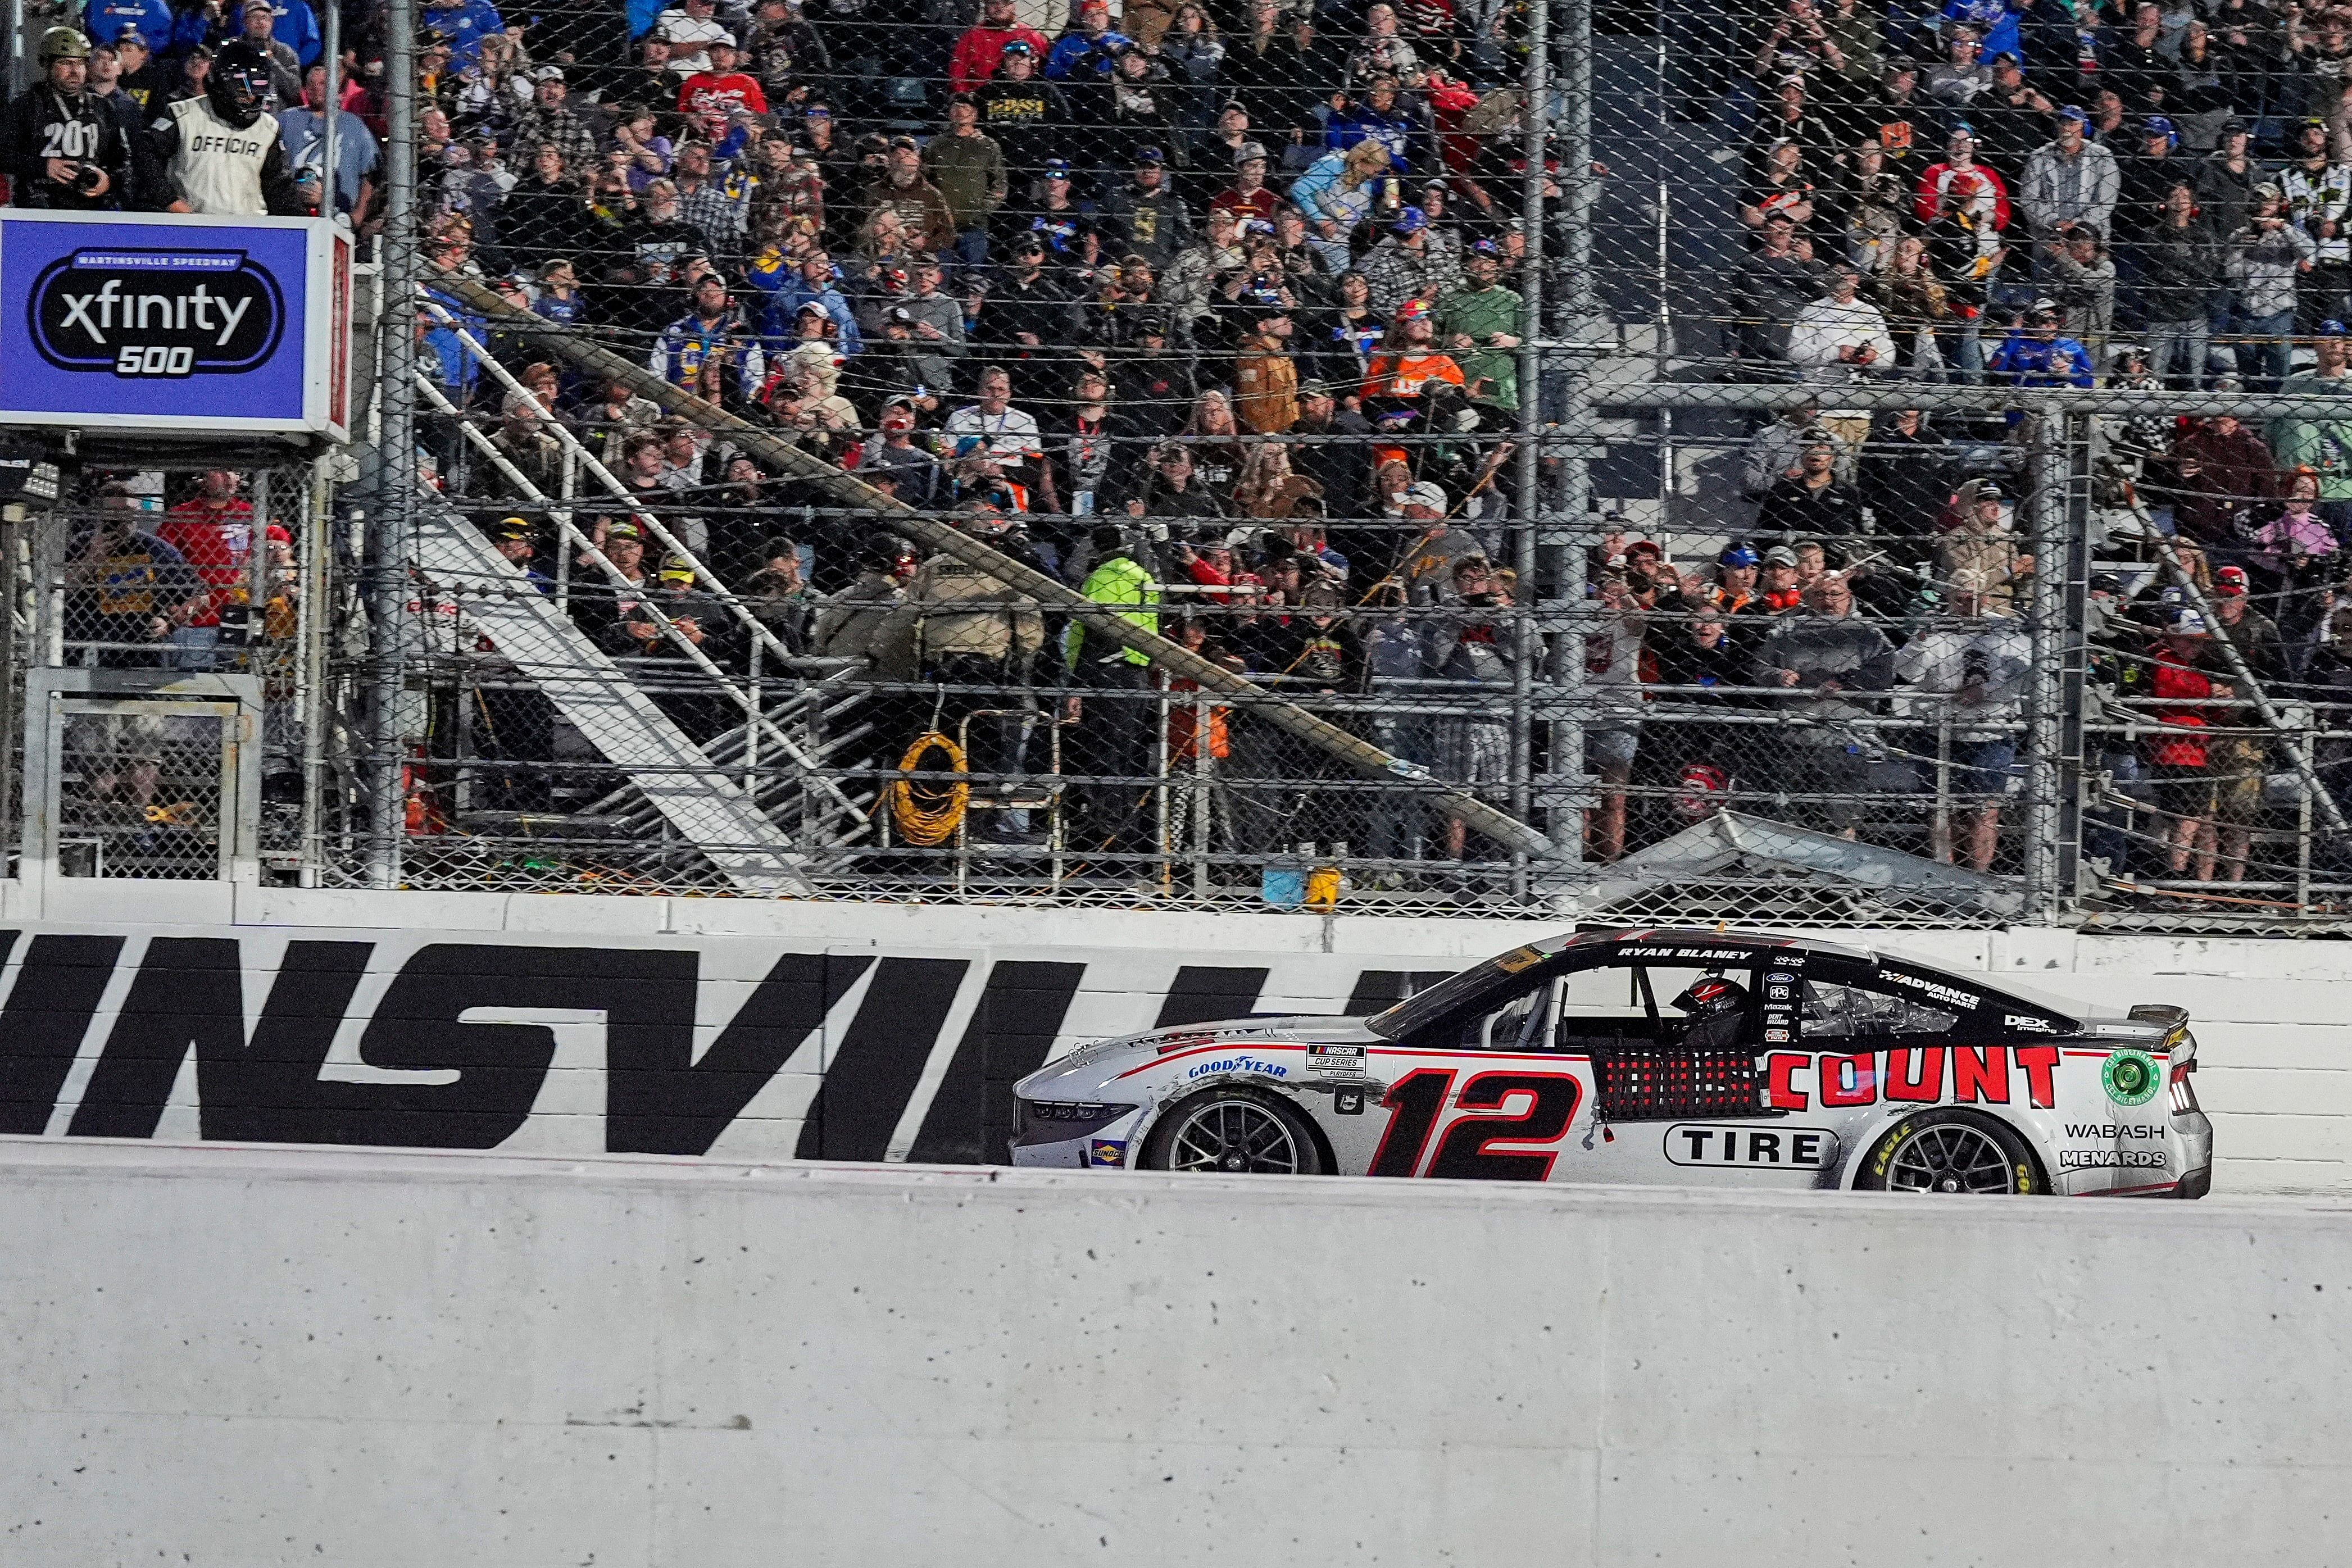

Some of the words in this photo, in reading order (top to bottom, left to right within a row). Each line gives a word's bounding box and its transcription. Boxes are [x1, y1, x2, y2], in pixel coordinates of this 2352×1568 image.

[191, 135, 261, 157] OFFICIA
[78, 257, 169, 265] MARTINSVILLE
[172, 258, 237, 266] SPEEDWAY
[60, 279, 253, 346] xfinity
[116, 346, 194, 374] 500
[1618, 948, 1673, 956] RYAN
[1677, 948, 1753, 960] BLANEY
[1771, 987, 1788, 998] PPG
[1897, 975, 1981, 1005] ADVANCE
[1927, 991, 1950, 1003] AUTO
[1950, 998, 1977, 1010] PARTS
[2004, 1015, 2050, 1029] DEX
[1326, 1047, 1357, 1056] NASCAR
[2105, 1056, 2117, 1068] GET
[2115, 1049, 2156, 1071] BIOETHANOL
[1366, 1067, 1583, 1182] 12
[2064, 1124, 2164, 1139] WABASH
[1682, 1130, 1820, 1165] TIRE
[1873, 1123, 1911, 1176] EAGLE
[2059, 1150, 2167, 1167] MENARDS
